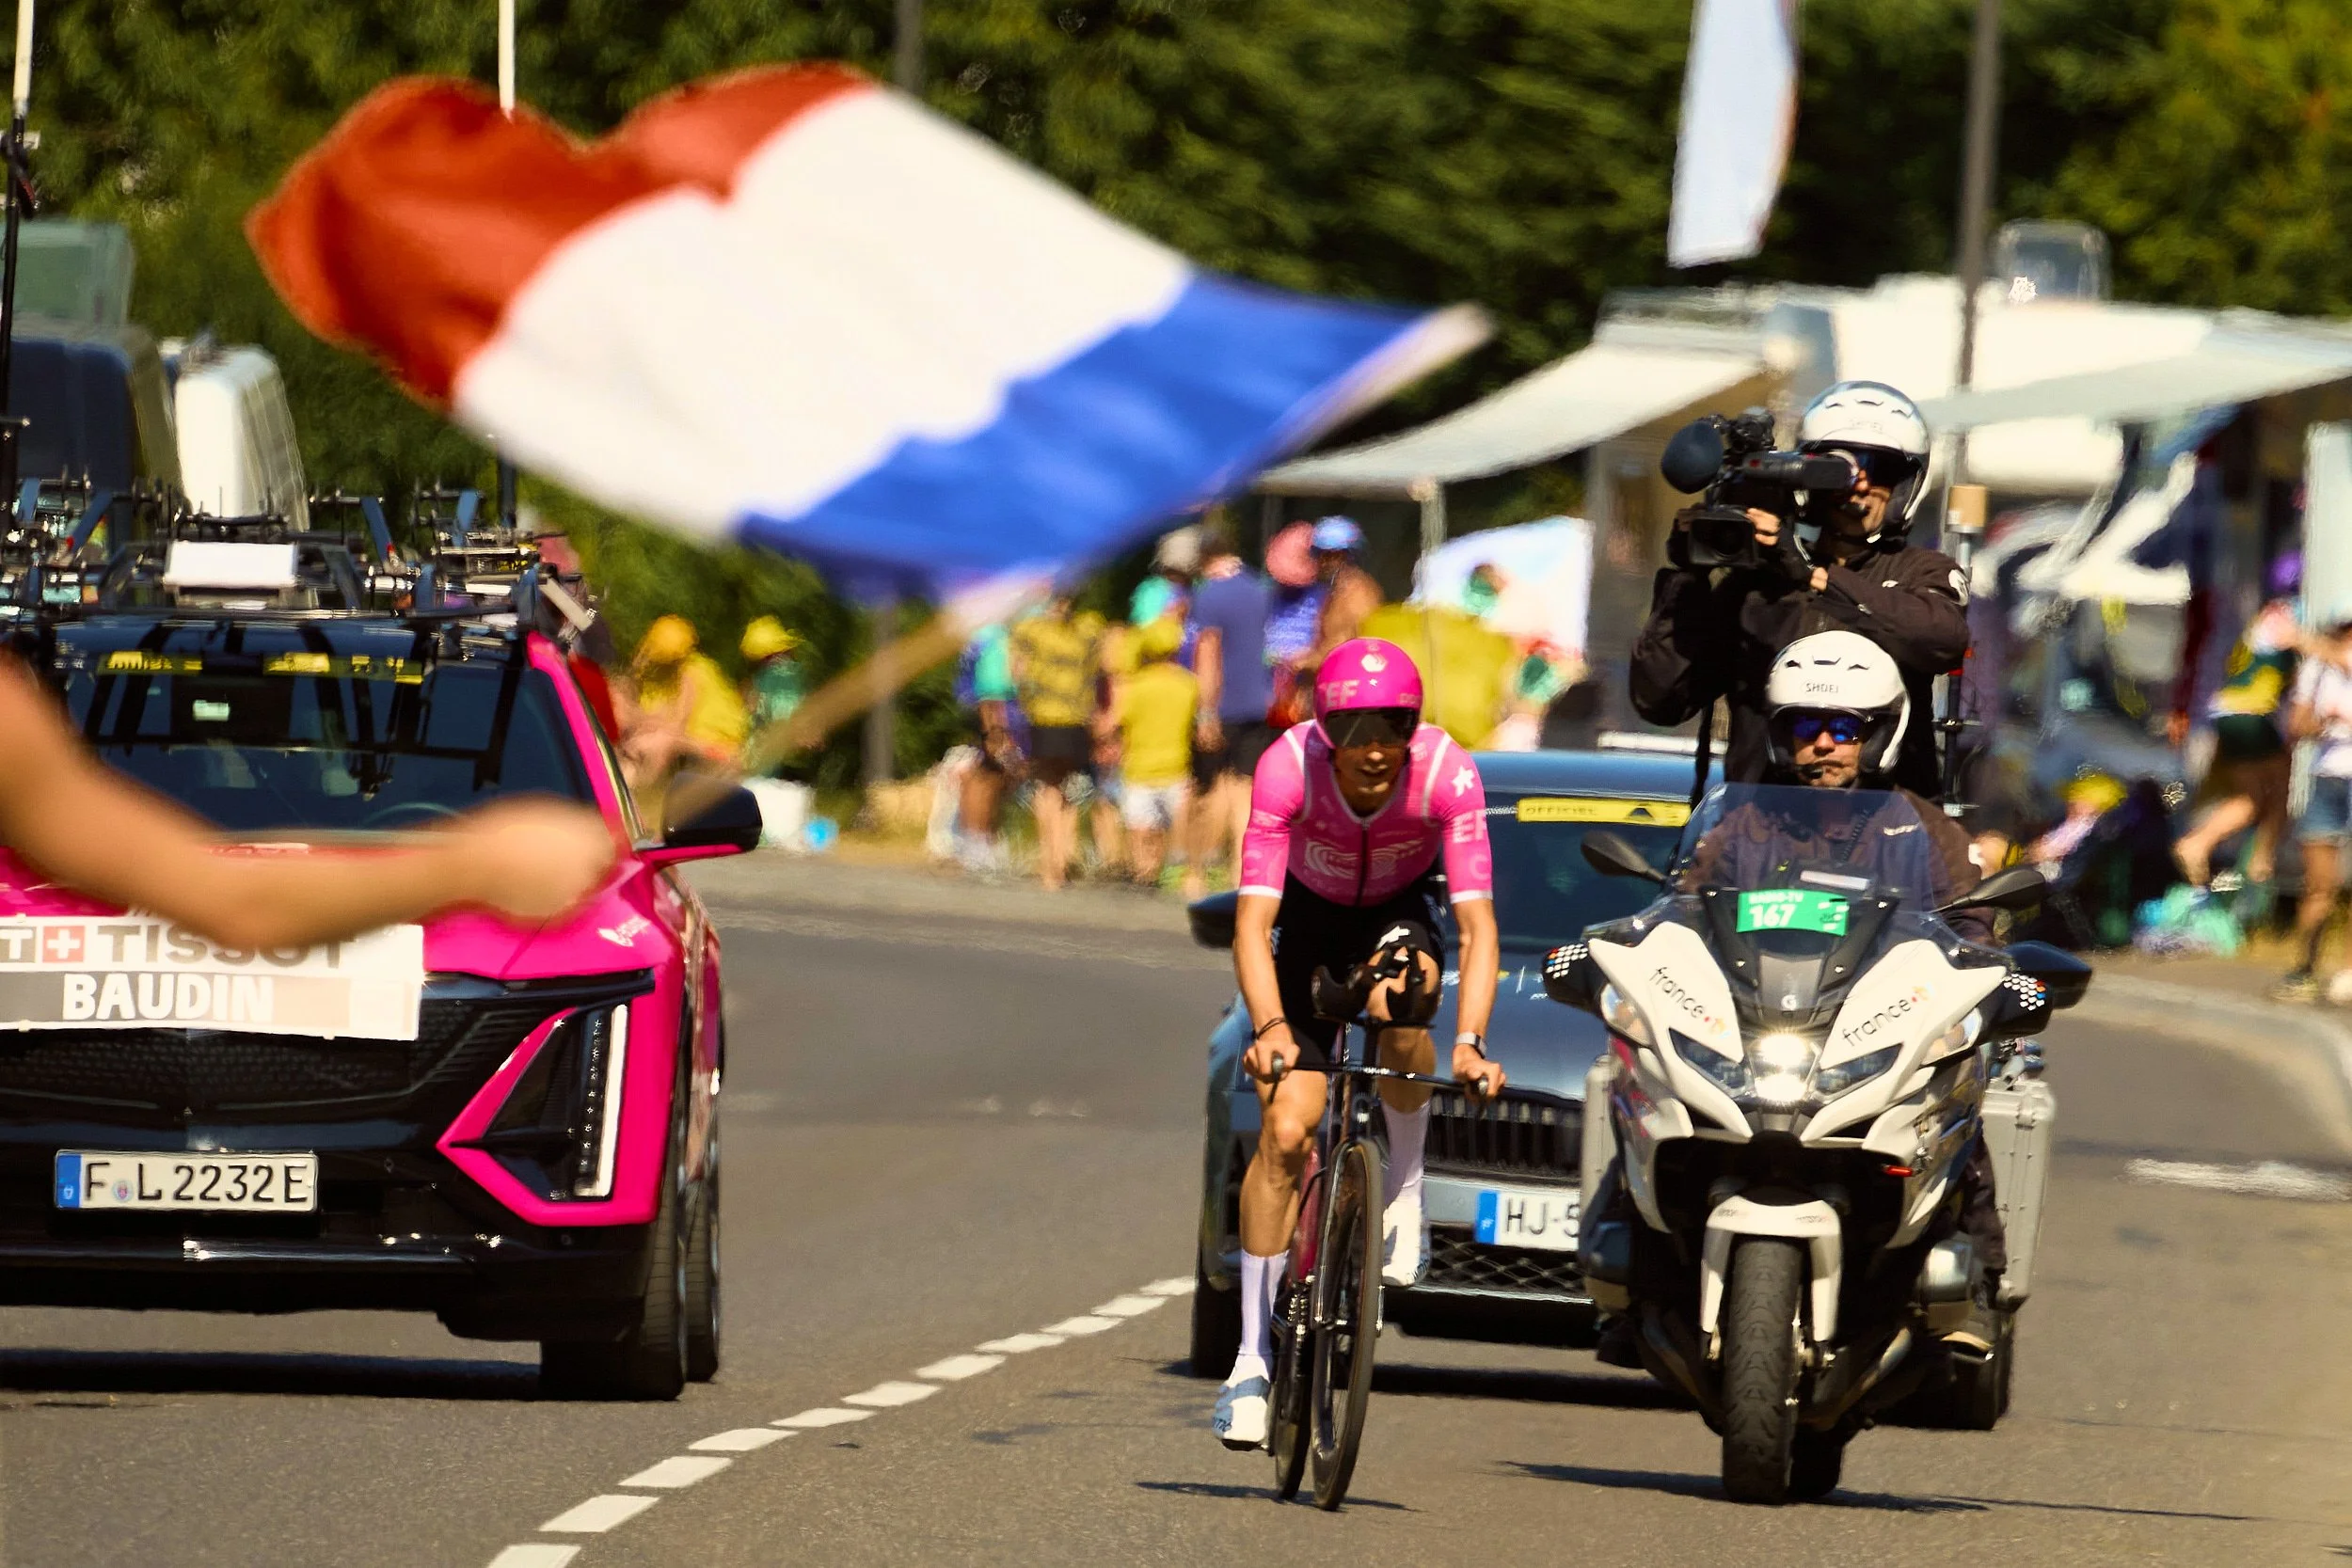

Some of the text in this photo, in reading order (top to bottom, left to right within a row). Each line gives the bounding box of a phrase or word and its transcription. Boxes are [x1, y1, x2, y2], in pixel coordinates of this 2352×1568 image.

[1805, 683, 1840, 694] SHOEI
[1525, 805, 1597, 817] OFFICIEL
[1749, 904, 1796, 928] 167
[63, 973, 275, 1022] BAUDIN
